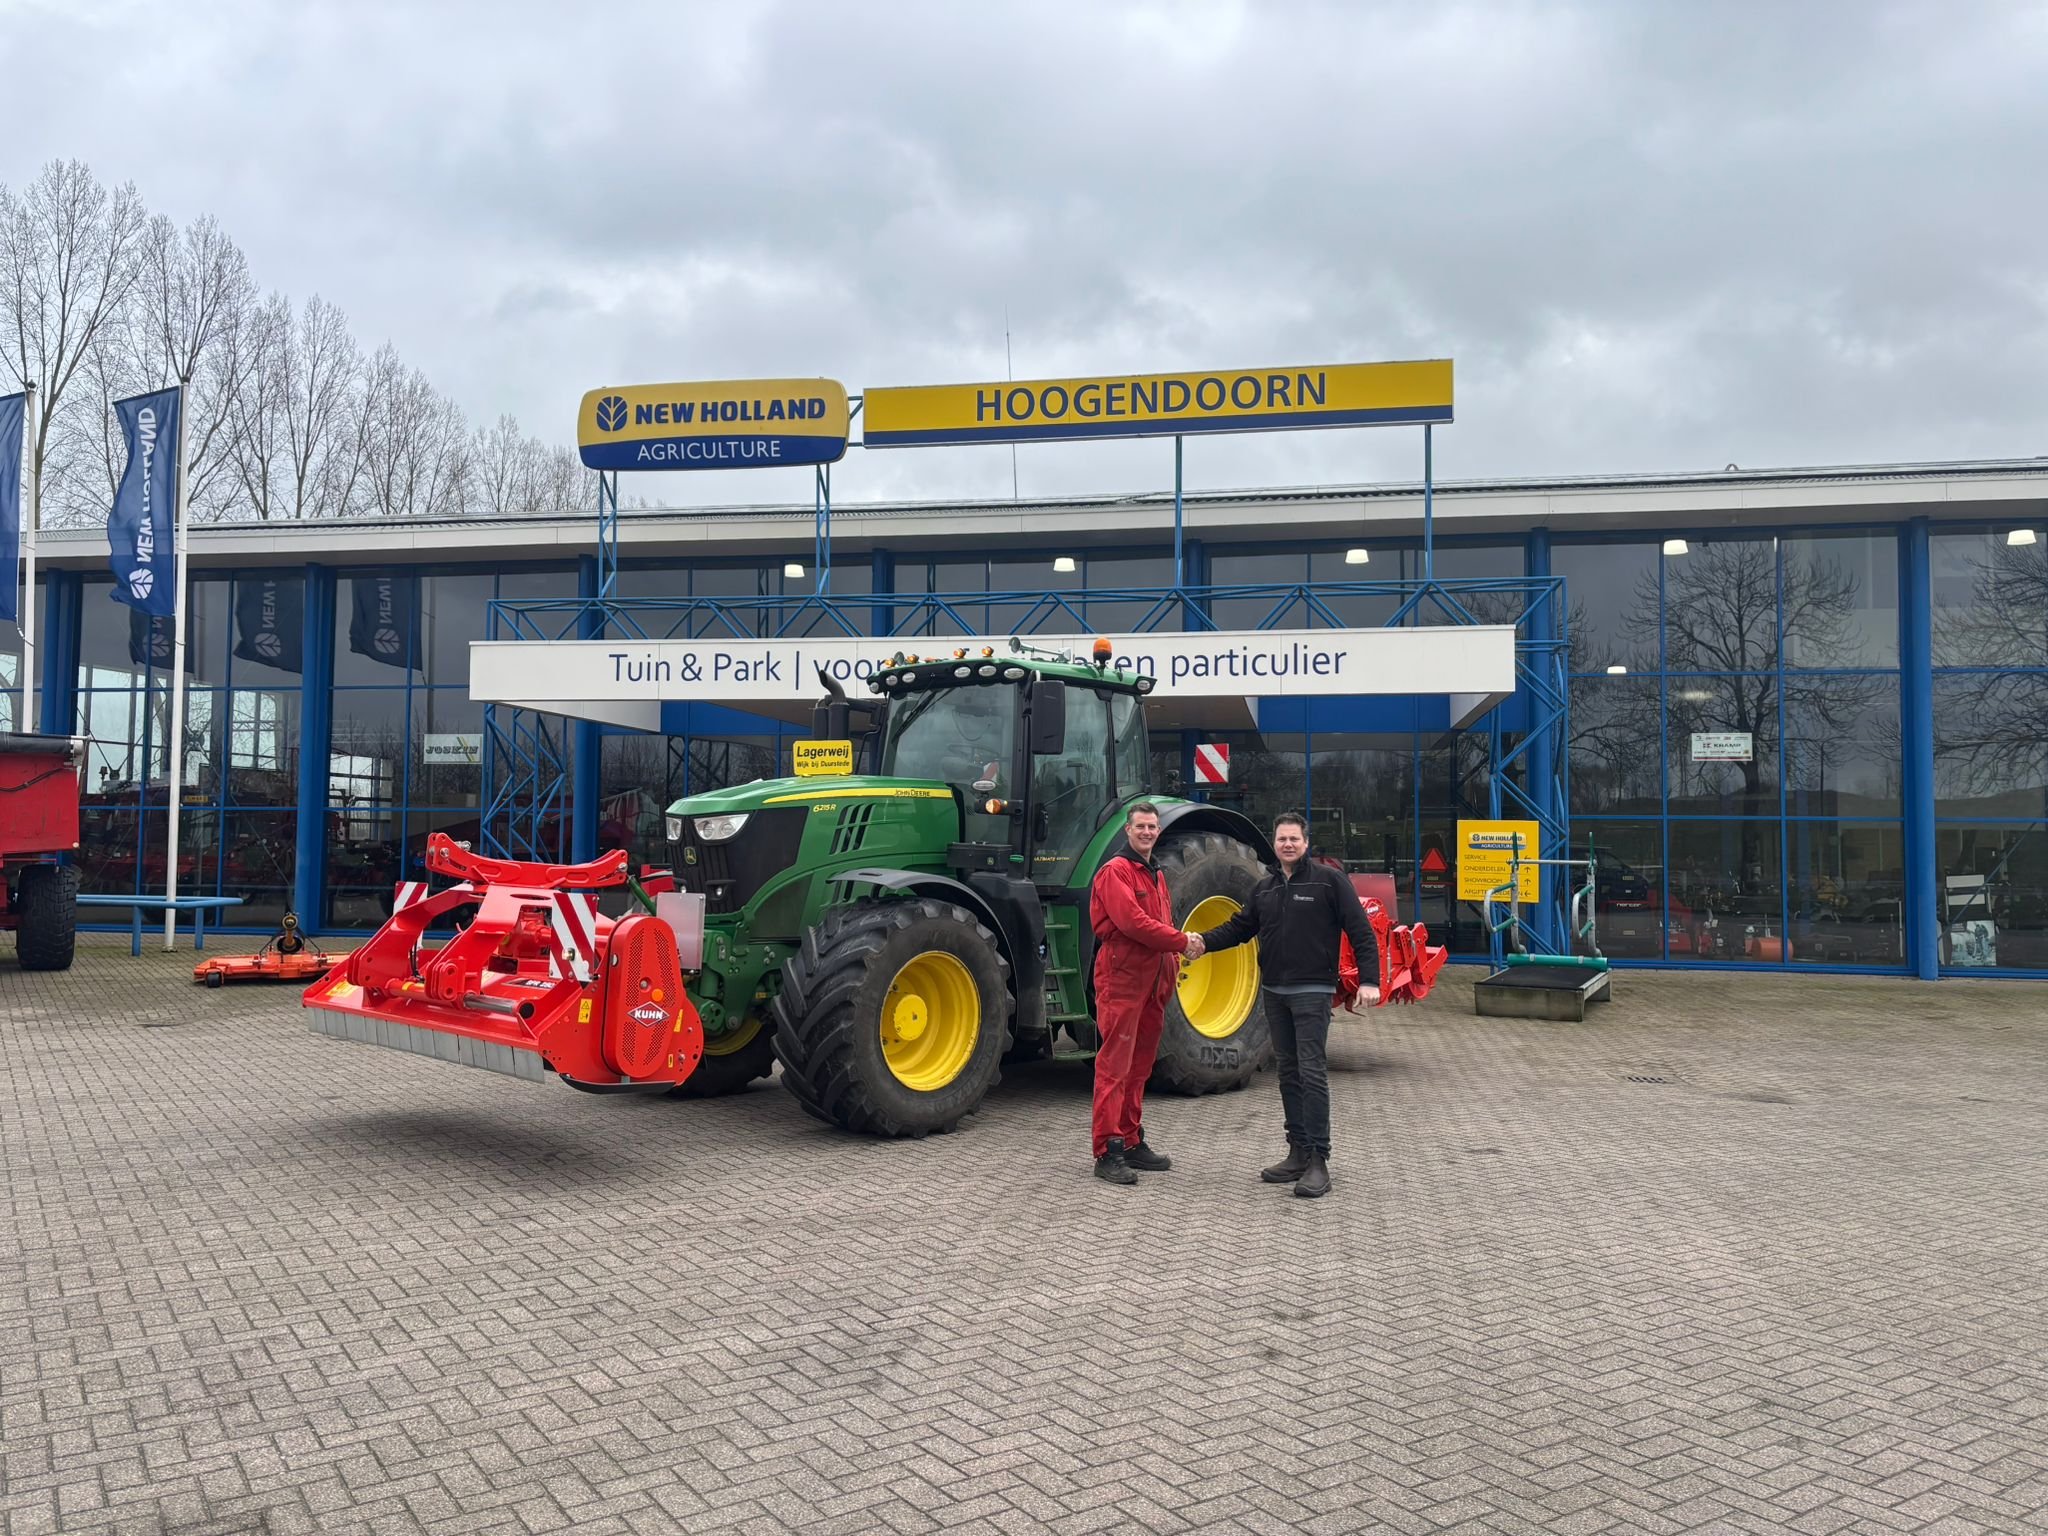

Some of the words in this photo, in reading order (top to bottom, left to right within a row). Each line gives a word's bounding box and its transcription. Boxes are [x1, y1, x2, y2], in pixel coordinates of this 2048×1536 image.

[976, 372, 1326, 422] HOOGENDOORN
[635, 402, 695, 425] NEW
[700, 397, 826, 423] HOLLAND
[637, 440, 781, 462] AGRICULTURE
[608, 653, 671, 682] Tuin
[680, 653, 703, 682] &
[713, 650, 782, 682] Park
[1171, 642, 1348, 687] particulier
[796, 745, 850, 760] Lagerweij
[634, 1010, 663, 1020] KUHN
